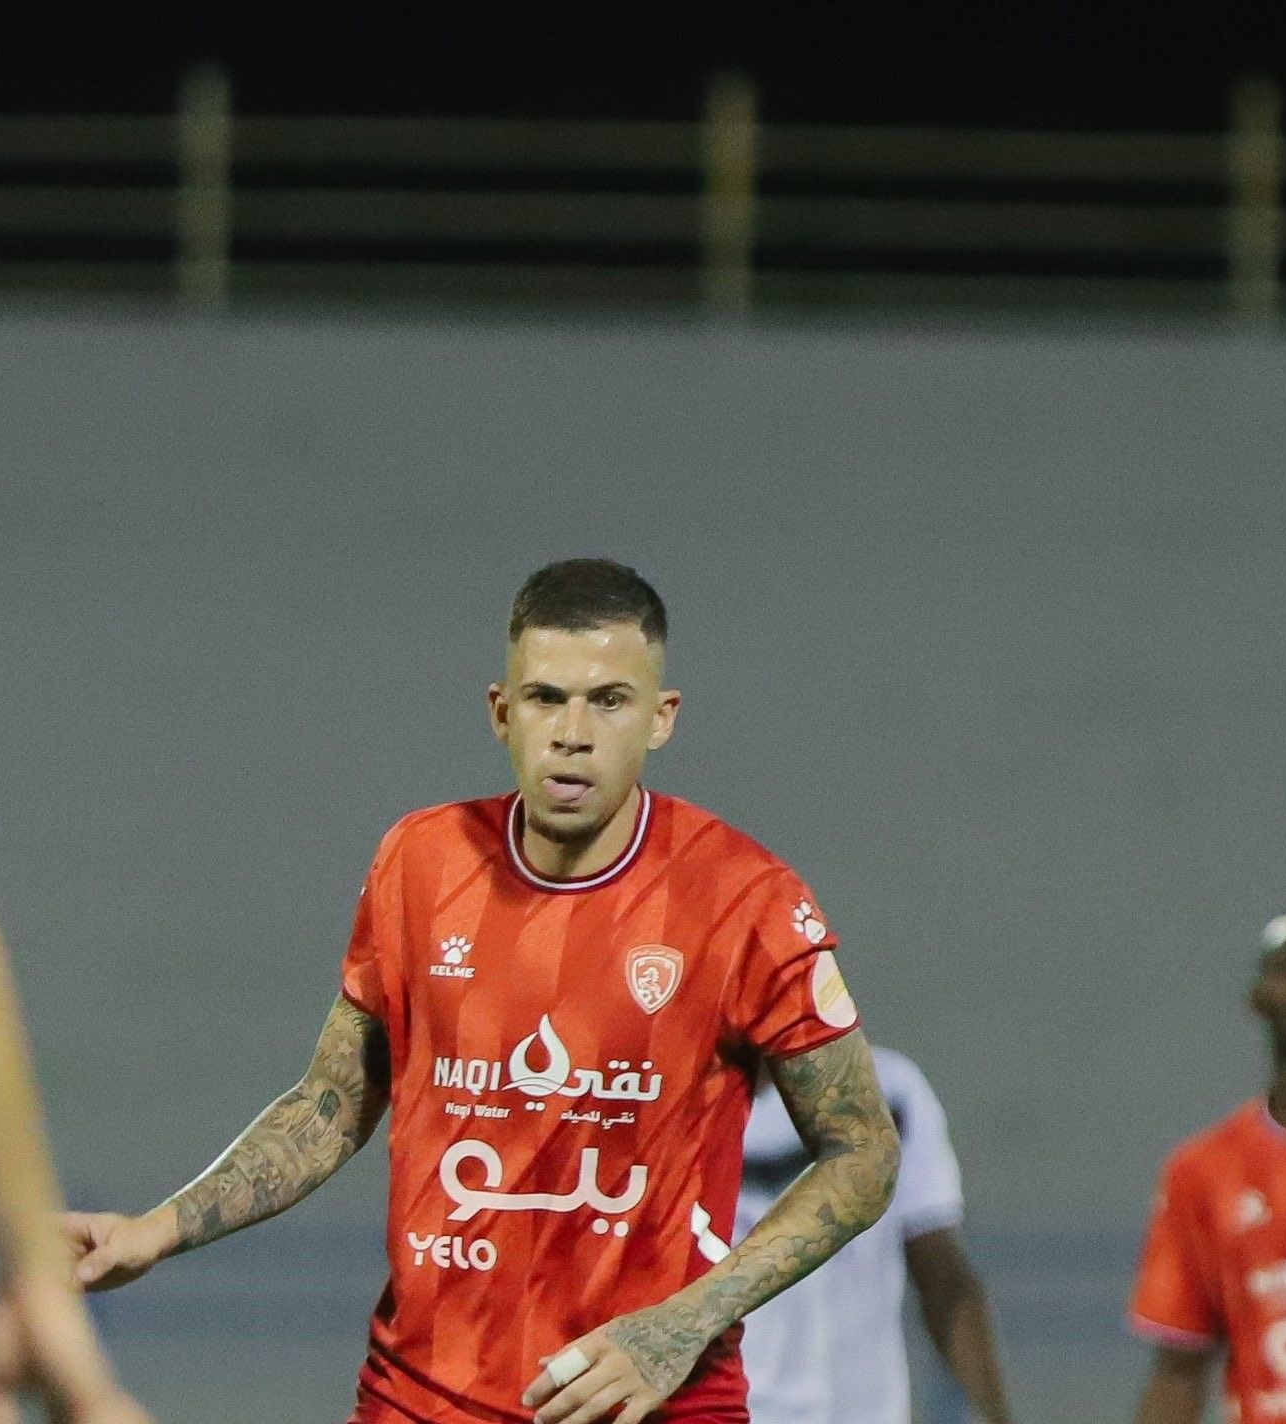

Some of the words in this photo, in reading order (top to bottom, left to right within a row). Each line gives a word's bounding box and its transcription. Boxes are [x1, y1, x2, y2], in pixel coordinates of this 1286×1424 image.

[429, 964, 476, 979] KELME
[433, 1056, 503, 1096] NAQI
[407, 1232, 498, 1271] YELO
